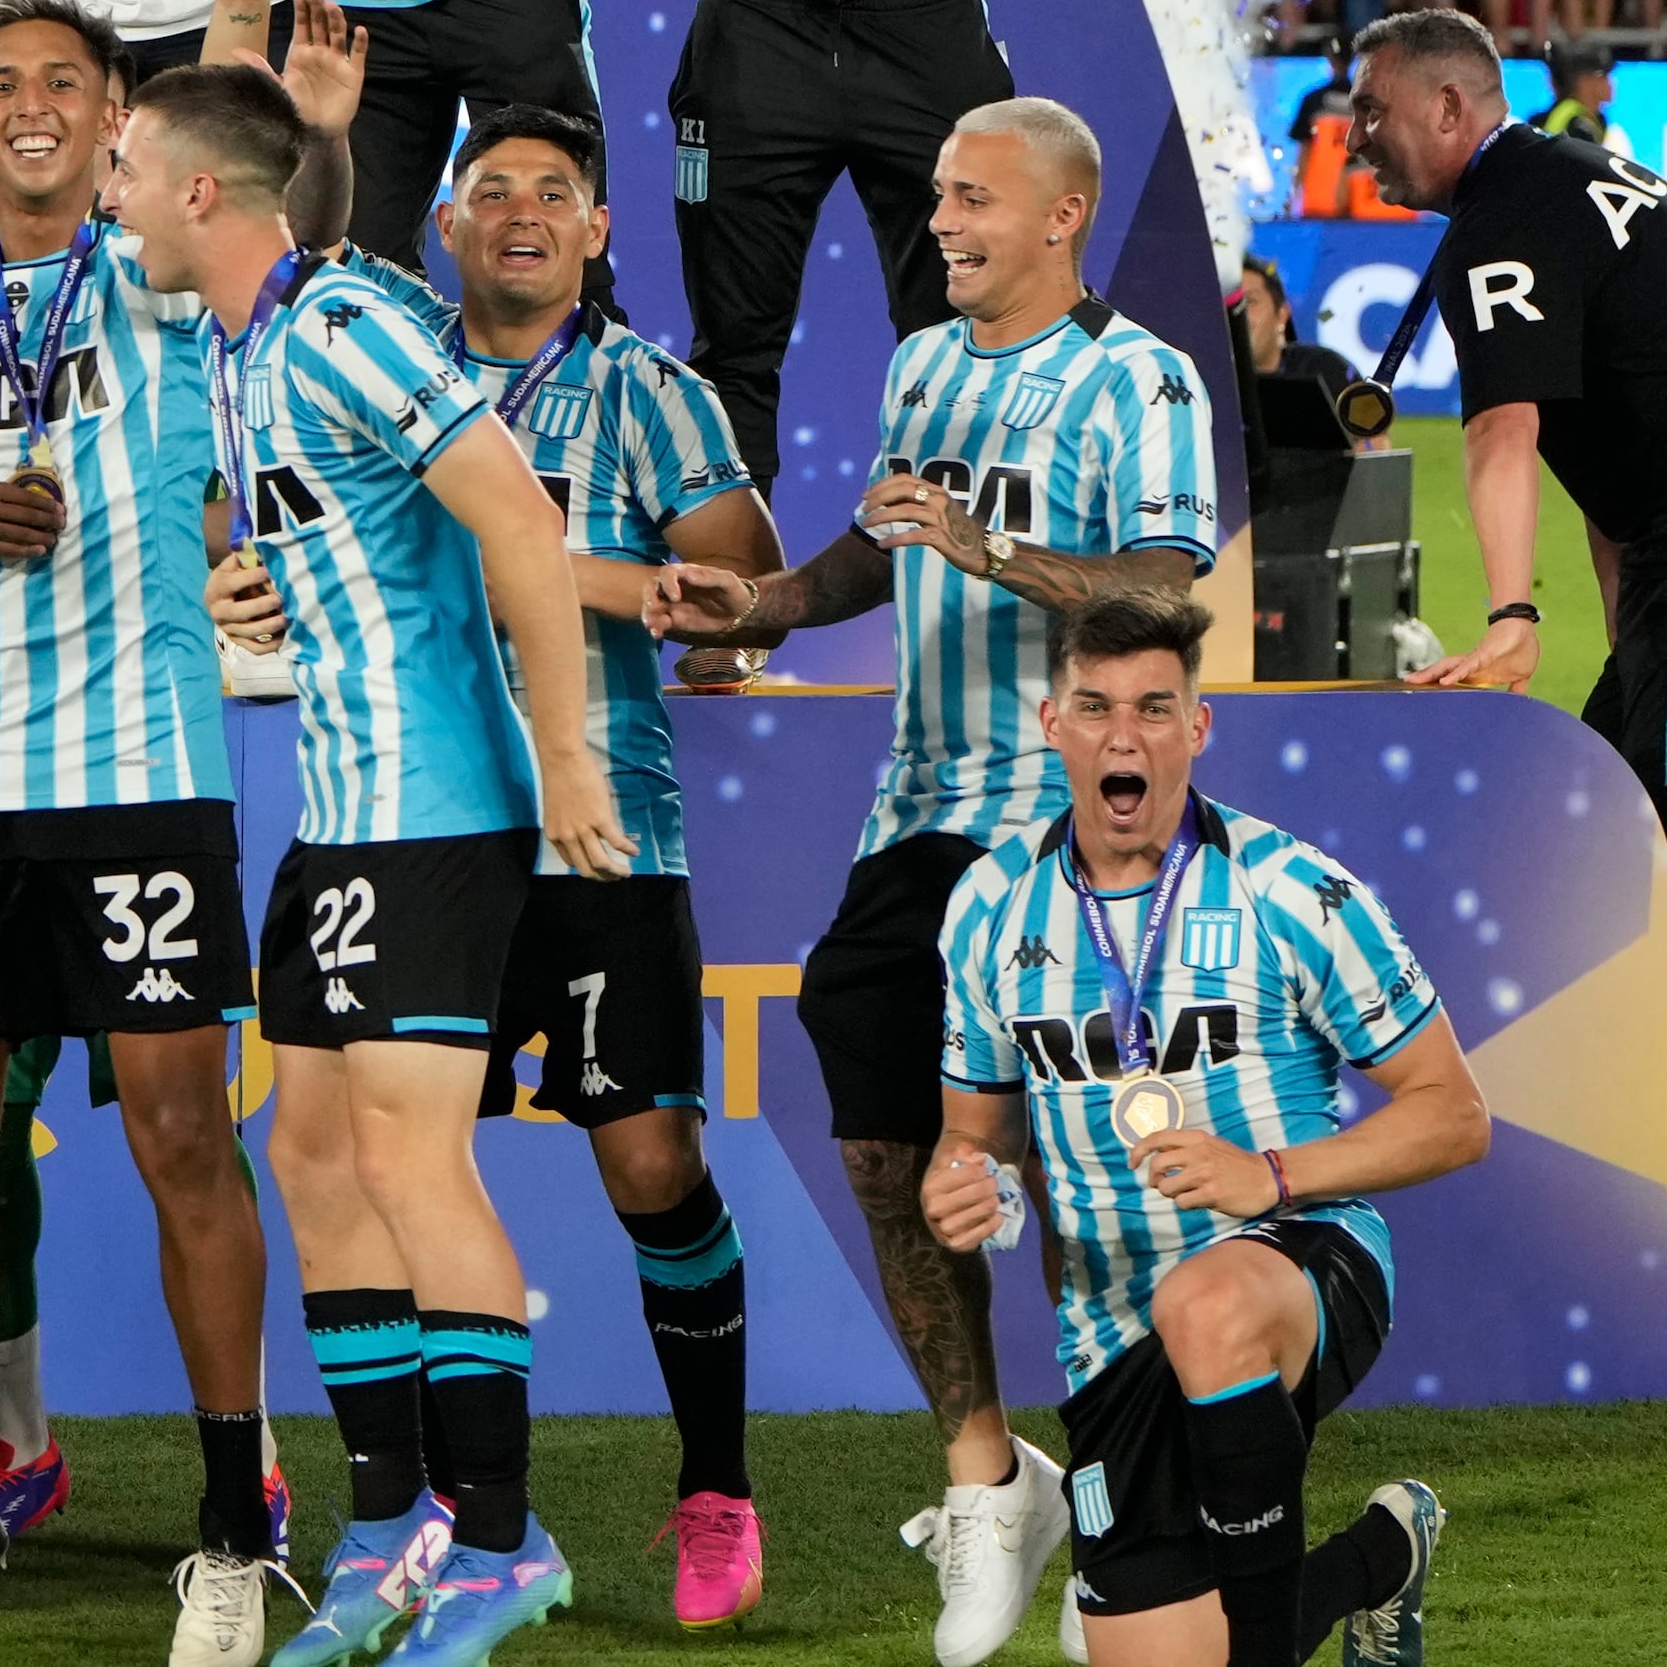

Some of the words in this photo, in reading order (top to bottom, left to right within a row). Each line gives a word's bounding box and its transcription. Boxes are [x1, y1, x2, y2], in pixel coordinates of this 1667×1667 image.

[48, 258, 82, 336] SUDAMERICANA
[508, 341, 564, 409] SUDAMERICANA
[544, 386, 588, 399] RACING
[1022, 377, 1061, 391] RACING
[1174, 492, 1215, 522] RUS
[93, 871, 200, 963] 32
[1148, 842, 1188, 927] SUDAMERICANA
[1187, 912, 1237, 922] RACING
[310, 875, 378, 974] 22
[1084, 895, 1113, 958] CONMEBOL
[567, 971, 607, 1060] 7
[1011, 1004, 1242, 1084] RCA
